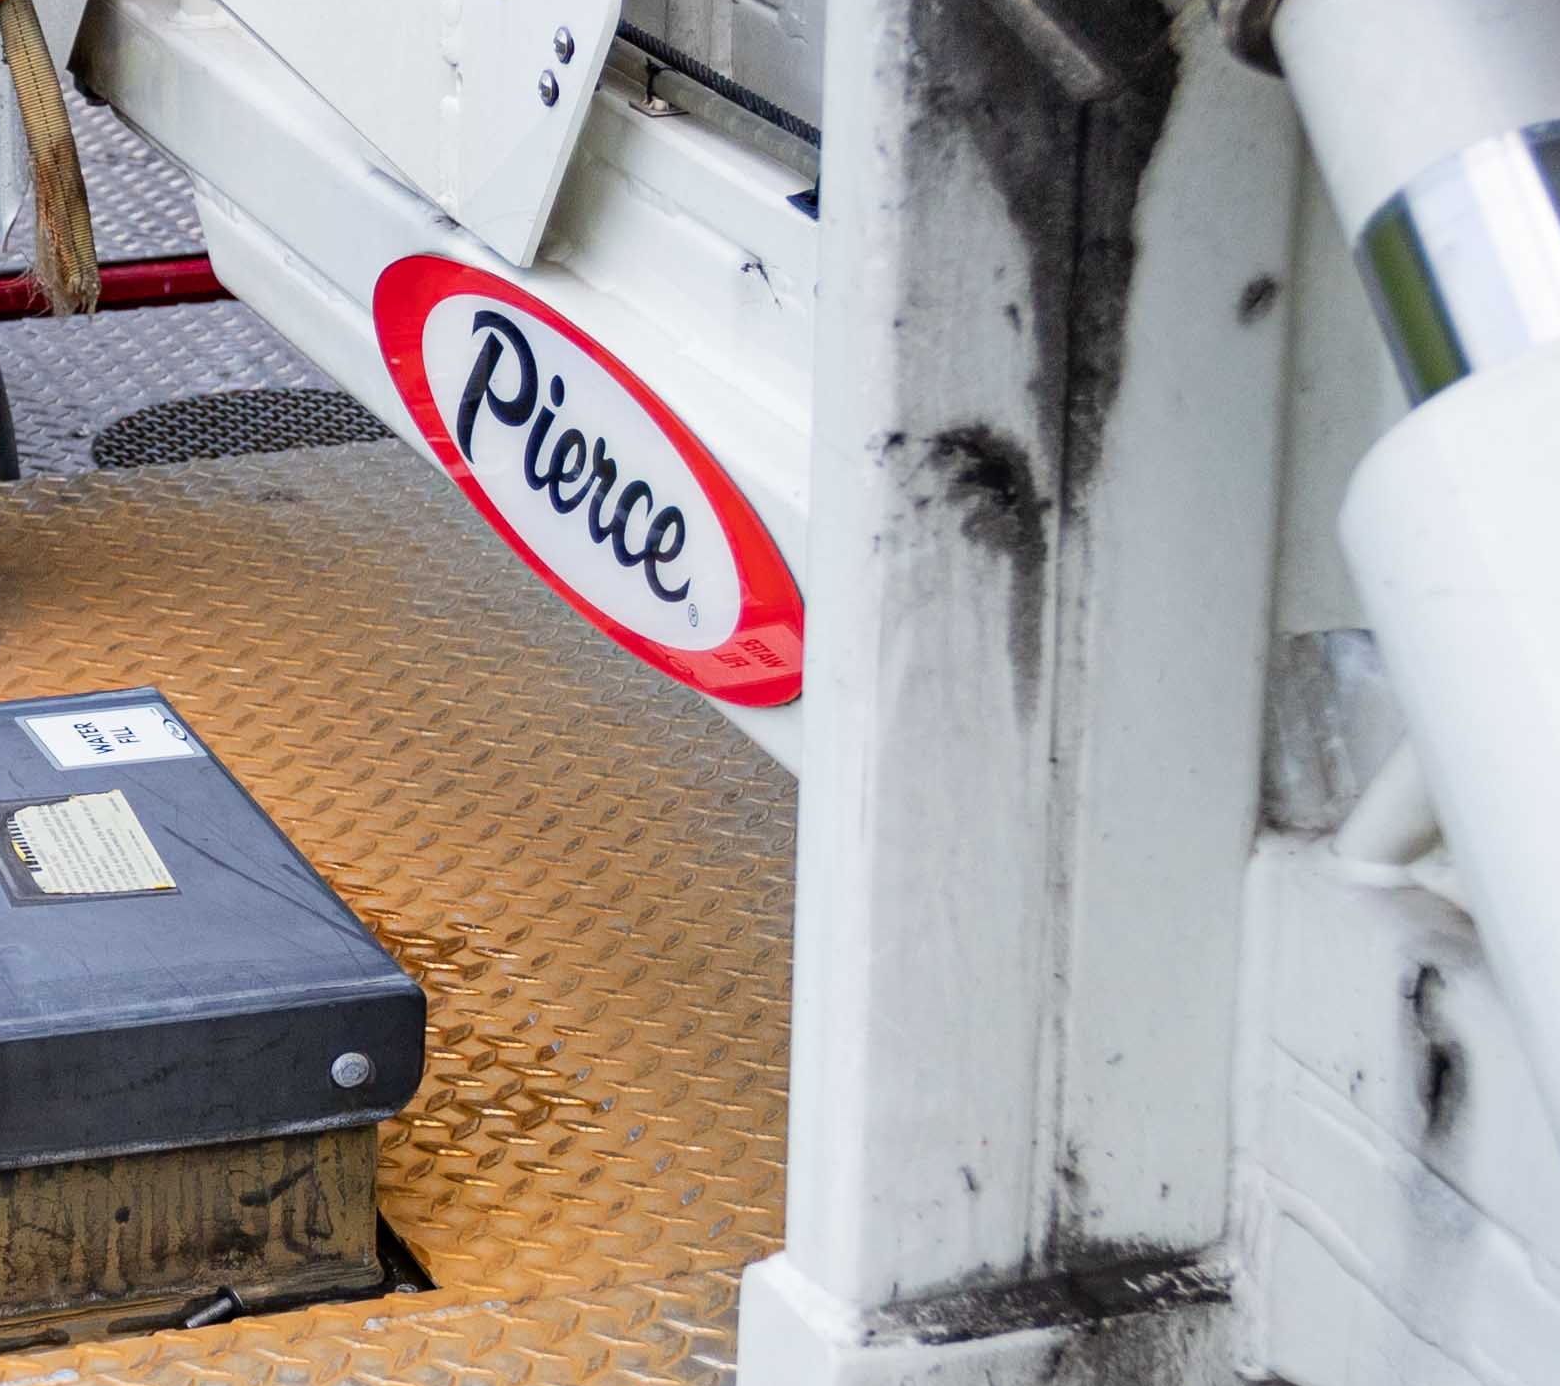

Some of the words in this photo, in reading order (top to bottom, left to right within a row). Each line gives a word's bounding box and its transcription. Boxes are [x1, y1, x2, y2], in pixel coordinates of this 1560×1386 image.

[455, 309, 692, 603] Pierce
[73, 721, 115, 755] WATER
[109, 725, 143, 745] FILL
